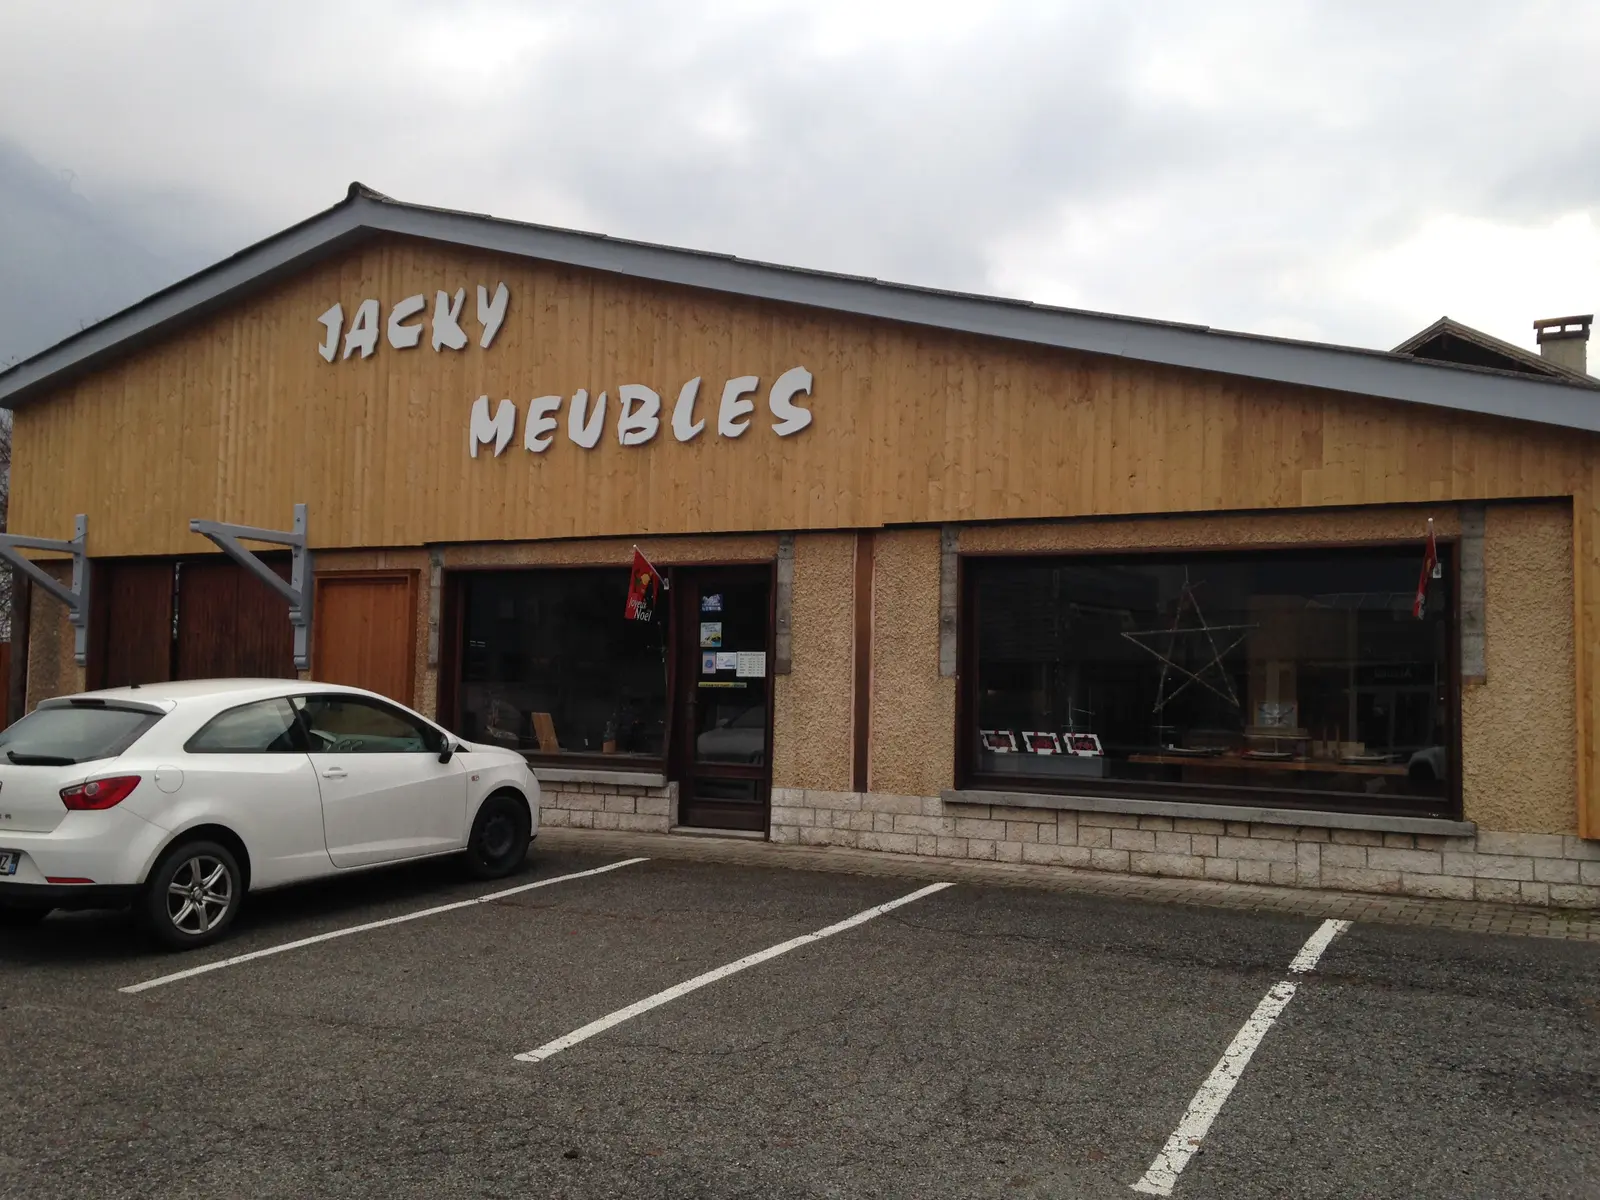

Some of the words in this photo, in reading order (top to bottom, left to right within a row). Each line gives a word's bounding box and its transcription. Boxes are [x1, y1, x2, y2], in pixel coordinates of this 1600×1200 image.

[317, 281, 510, 363] JACKY
[469, 366, 813, 459] MEUBLES
[628, 597, 648, 610] Joyeux
